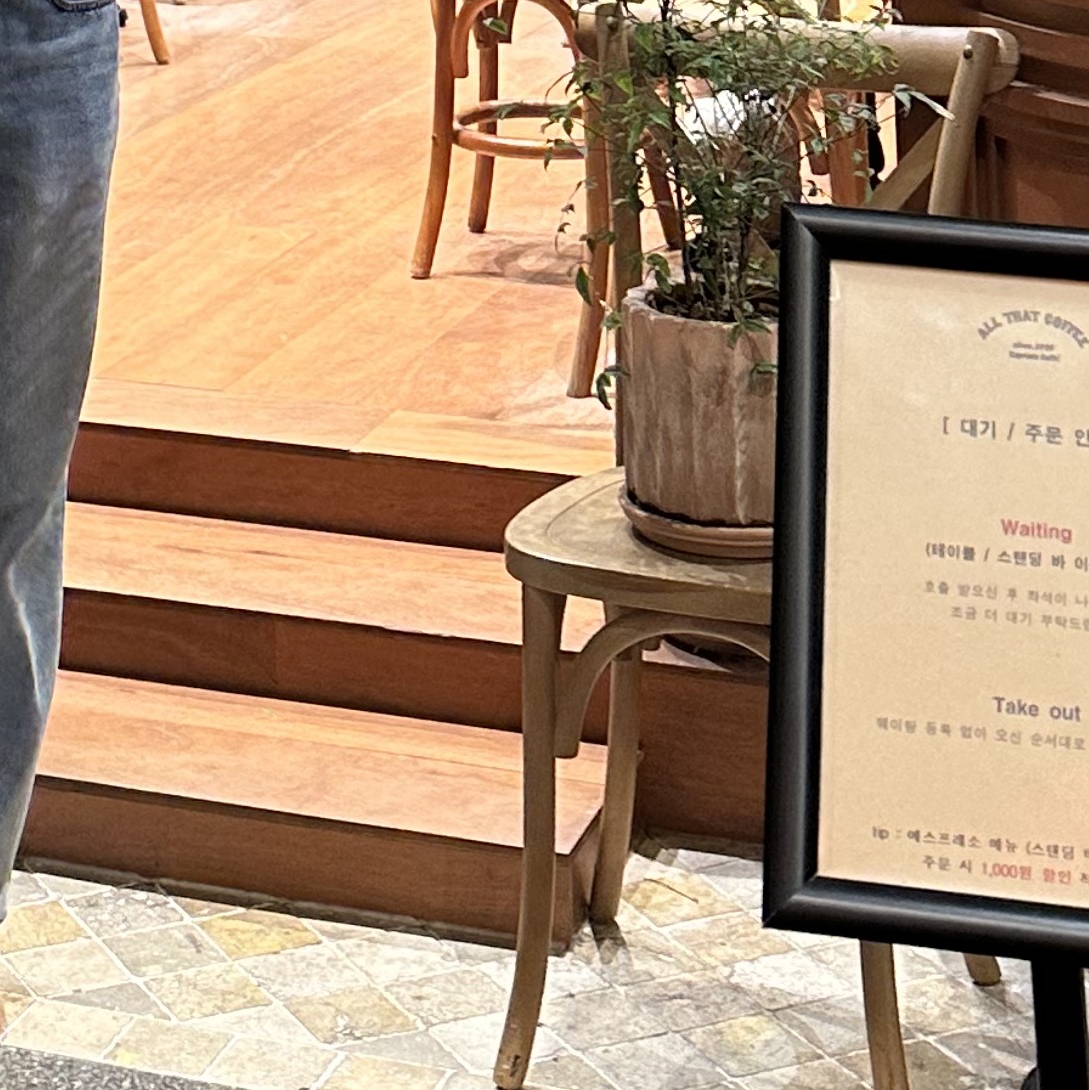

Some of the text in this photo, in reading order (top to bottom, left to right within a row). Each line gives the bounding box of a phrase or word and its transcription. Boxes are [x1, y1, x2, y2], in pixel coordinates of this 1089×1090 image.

[1002, 309, 1040, 324] THAT
[960, 419, 996, 439] 대기
[1024, 423, 1063, 445] 주문
[999, 519, 1073, 544] Waiting
[1051, 554, 1066, 570] 바
[983, 608, 998, 623] 더
[991, 696, 1082, 722] Take out
[921, 855, 951, 871] 주문
[981, 862, 1032, 881] 1,000원
